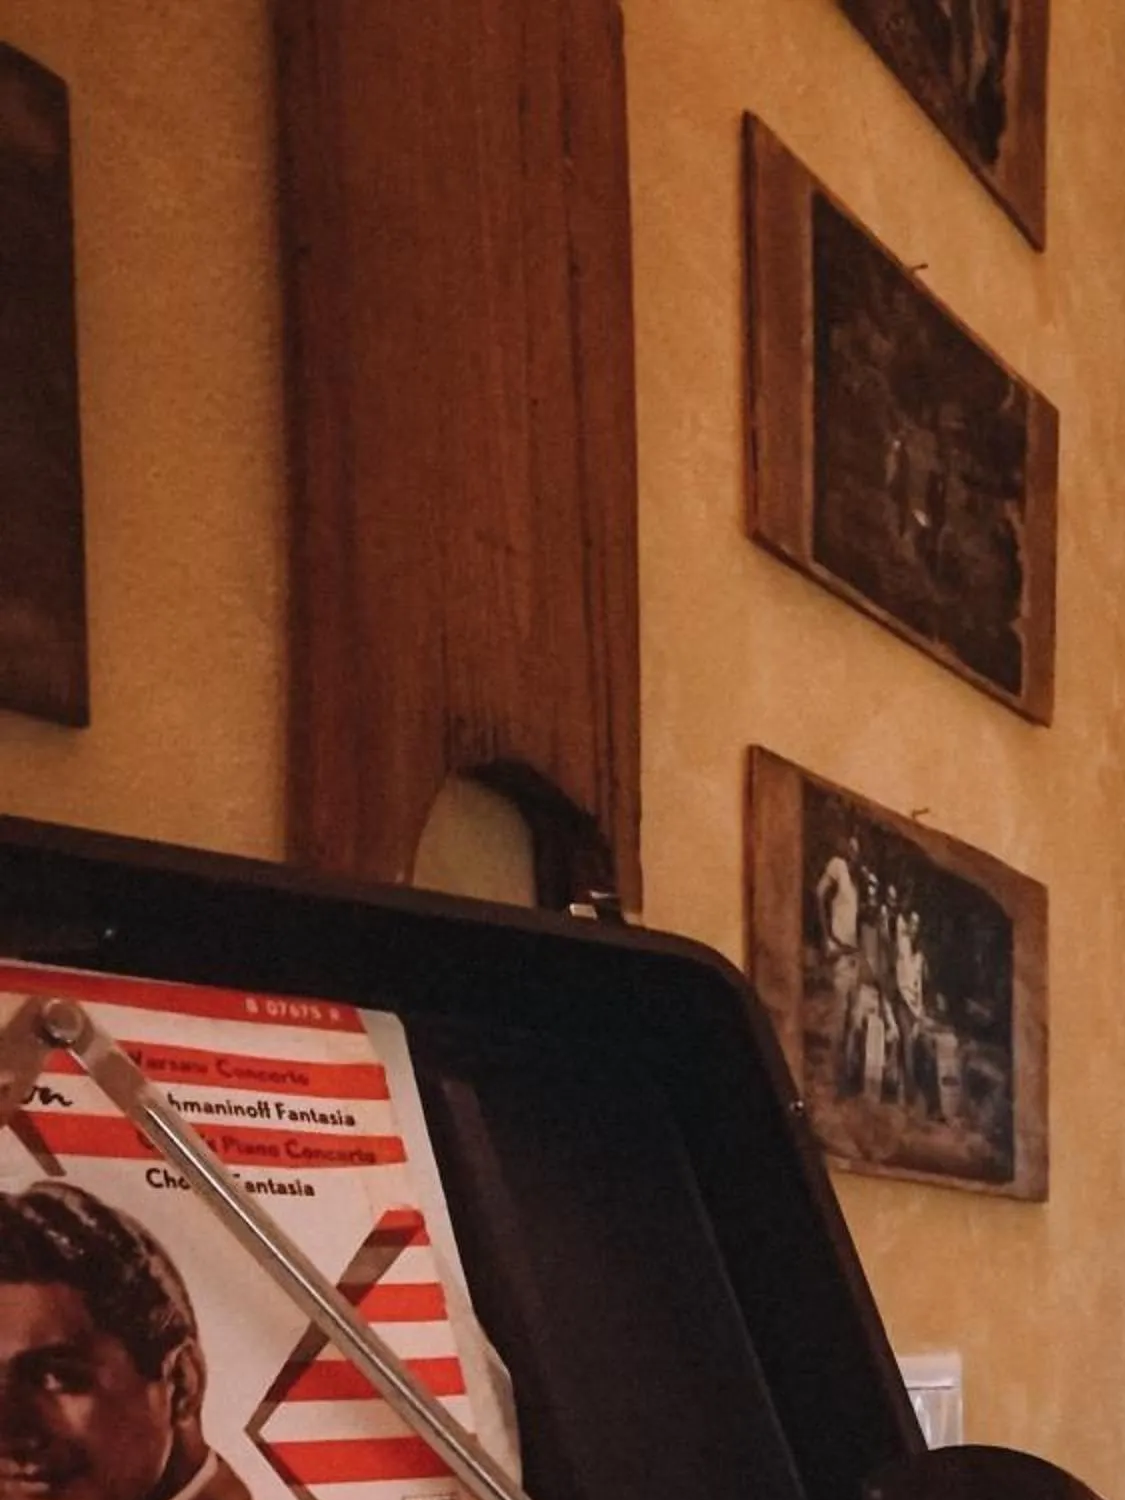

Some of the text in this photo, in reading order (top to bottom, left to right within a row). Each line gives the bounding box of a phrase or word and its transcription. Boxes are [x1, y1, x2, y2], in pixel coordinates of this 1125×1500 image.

[216, 1057, 310, 1086] Concerto
[167, 1092, 356, 1127] hmaninoff Fantasia
[284, 1138, 377, 1165] Concerto
[145, 1167, 316, 1197] Cho antasia
